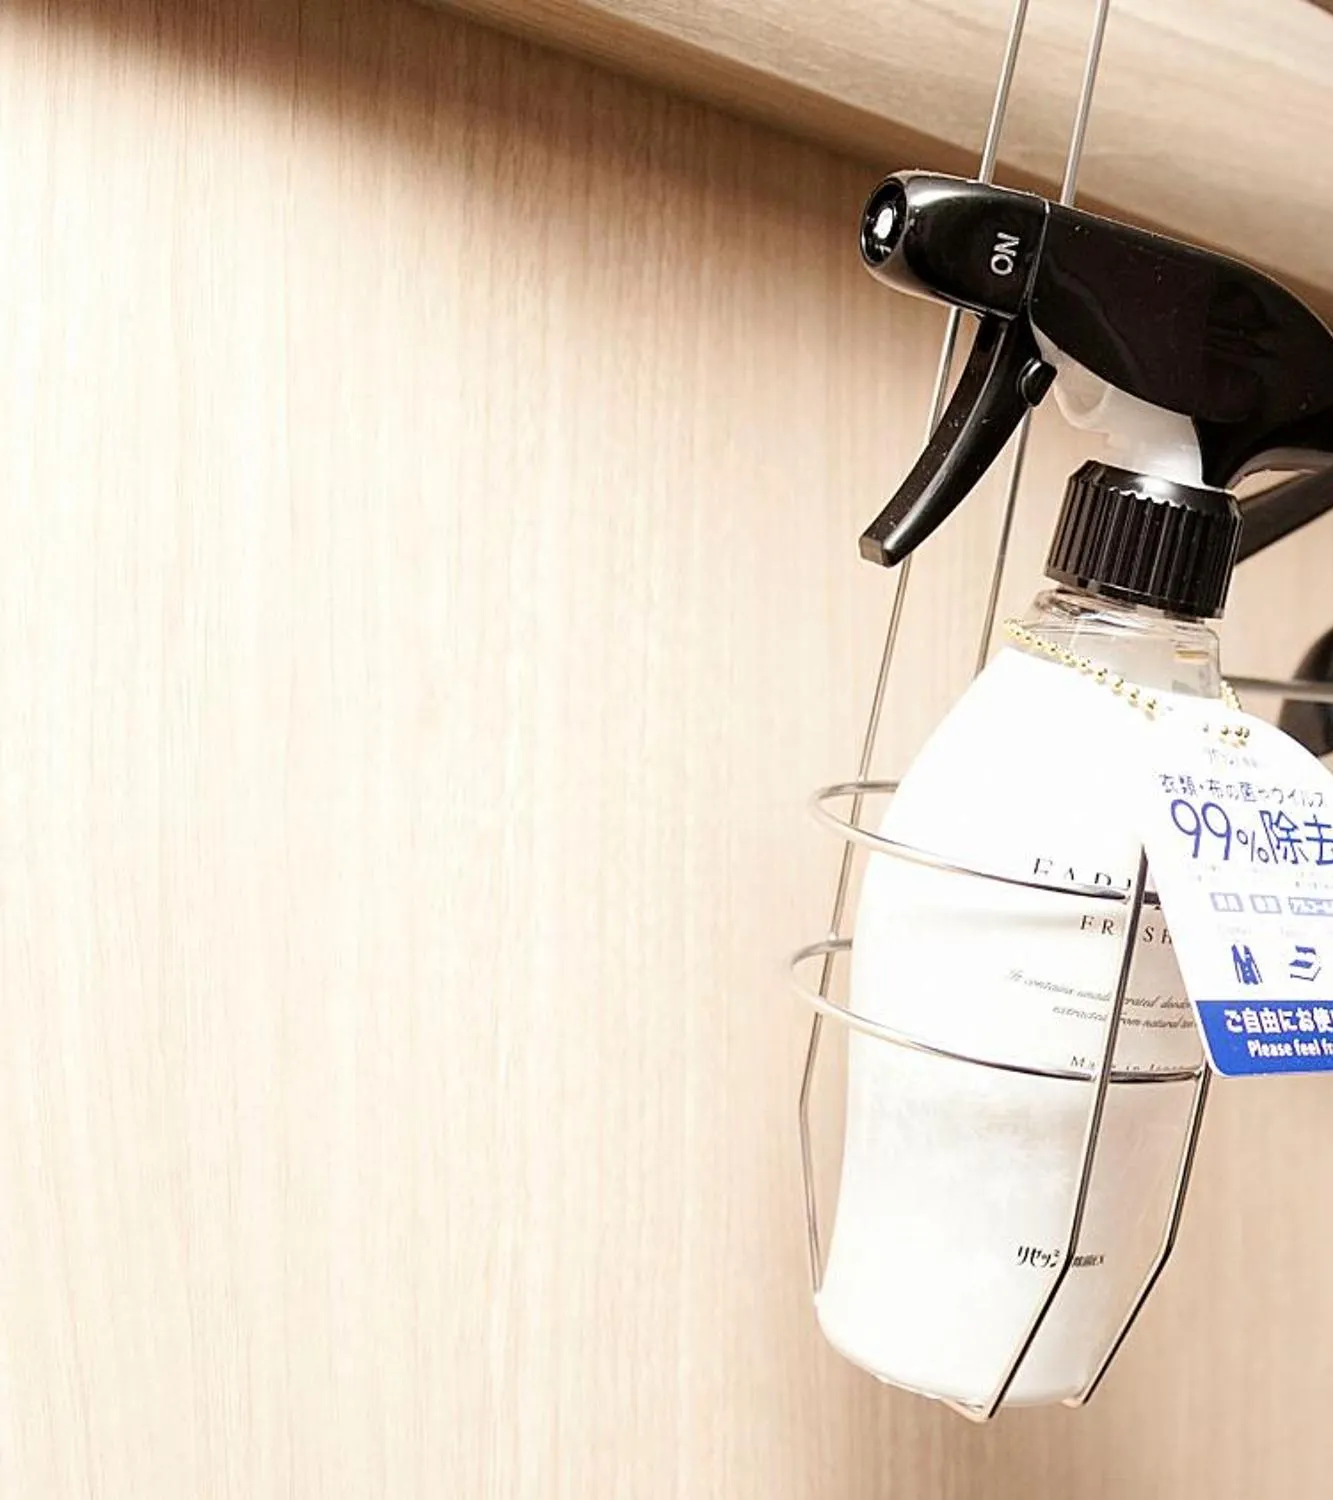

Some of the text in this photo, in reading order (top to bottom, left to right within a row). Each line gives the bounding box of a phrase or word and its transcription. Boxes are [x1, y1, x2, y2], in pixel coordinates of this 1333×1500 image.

[991, 232, 1020, 275] ON
[1080, 914, 1172, 945] FRSH
[1247, 1039, 1294, 1058] Please
[1294, 1038, 1322, 1057] feel
